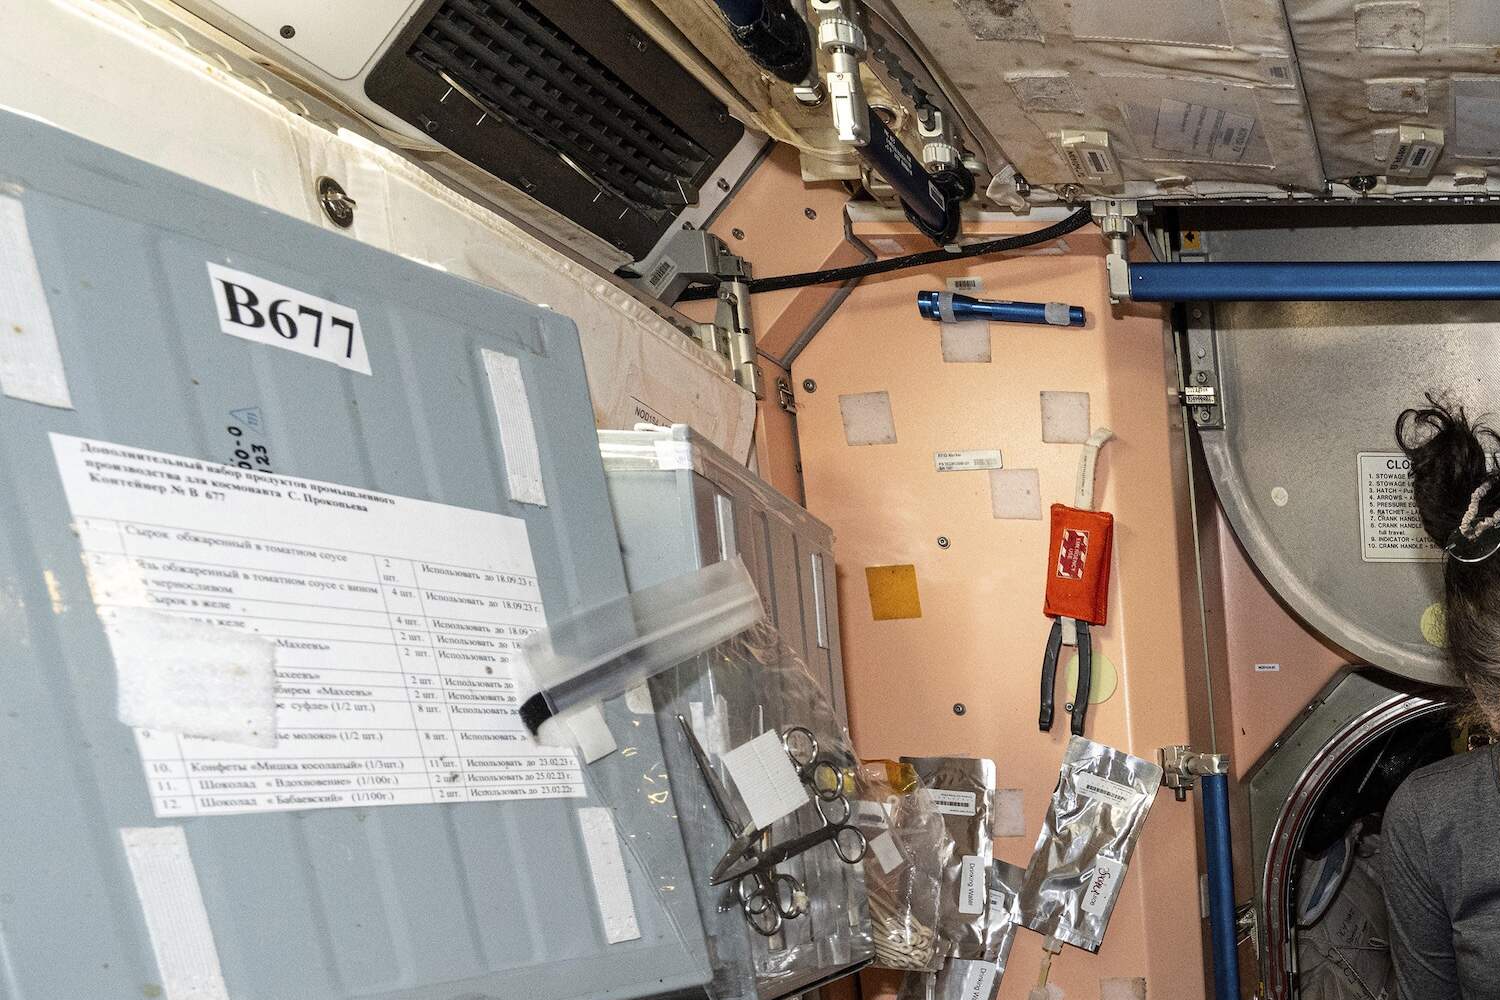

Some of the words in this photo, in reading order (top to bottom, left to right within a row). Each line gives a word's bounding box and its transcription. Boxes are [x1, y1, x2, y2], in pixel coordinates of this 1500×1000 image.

[215, 277, 354, 358] B677
[80, 441, 204, 471] Дополнительный
[206, 464, 243, 480] набор
[246, 473, 307, 490] продуктов
[310, 483, 396, 505] промышленного
[84, 459, 181, 481] производства
[186, 475, 208, 487] для
[212, 479, 282, 498] космонавта
[303, 493, 368, 512] Прокопьева
[88, 473, 167, 495] Контейнер
[205, 491, 226, 502] 677
[176, 531, 252, 551] обжаренный
[265, 545, 318, 559] томатном
[319, 552, 348, 562] соусе
[163, 562, 239, 580] обжаренный
[253, 573, 306, 587] томатном
[307, 580, 337, 590] соусе
[421, 564, 481, 580] Использовать
[496, 574, 528, 587] 18.09.23
[425, 592, 485, 606] Использовать
[502, 600, 533, 612] 18.09.23
[432, 619, 491, 633] Использовать
[436, 635, 495, 649] Использовать
[438, 651, 496, 662] Использовать
[444, 678, 502, 689] Использовать
[447, 691, 506, 702] Использовать
[507, 695, 517, 703] до
[450, 705, 508, 715] Использовать
[460, 732, 517, 741] Использовать
[152, 763, 172, 774] 10.
[191, 762, 248, 774] Конфеты
[250, 762, 298, 772] «Мишка
[301, 760, 363, 771] косолапый»
[466, 759, 522, 770] Использовать
[539, 757, 569, 767] 23.02.23
[200, 780, 257, 791] Шоколад
[275, 776, 352, 788] Вдохновение»
[467, 773, 524, 783] Использовать
[536, 772, 566, 781] 25.02.23
[470, 787, 526, 797] Использовать
[200, 797, 258, 808] Шоколад
[276, 794, 344, 806] Бабаевский»
[968, 863, 976, 890] Drinking
[973, 967, 987, 994] Drinking
